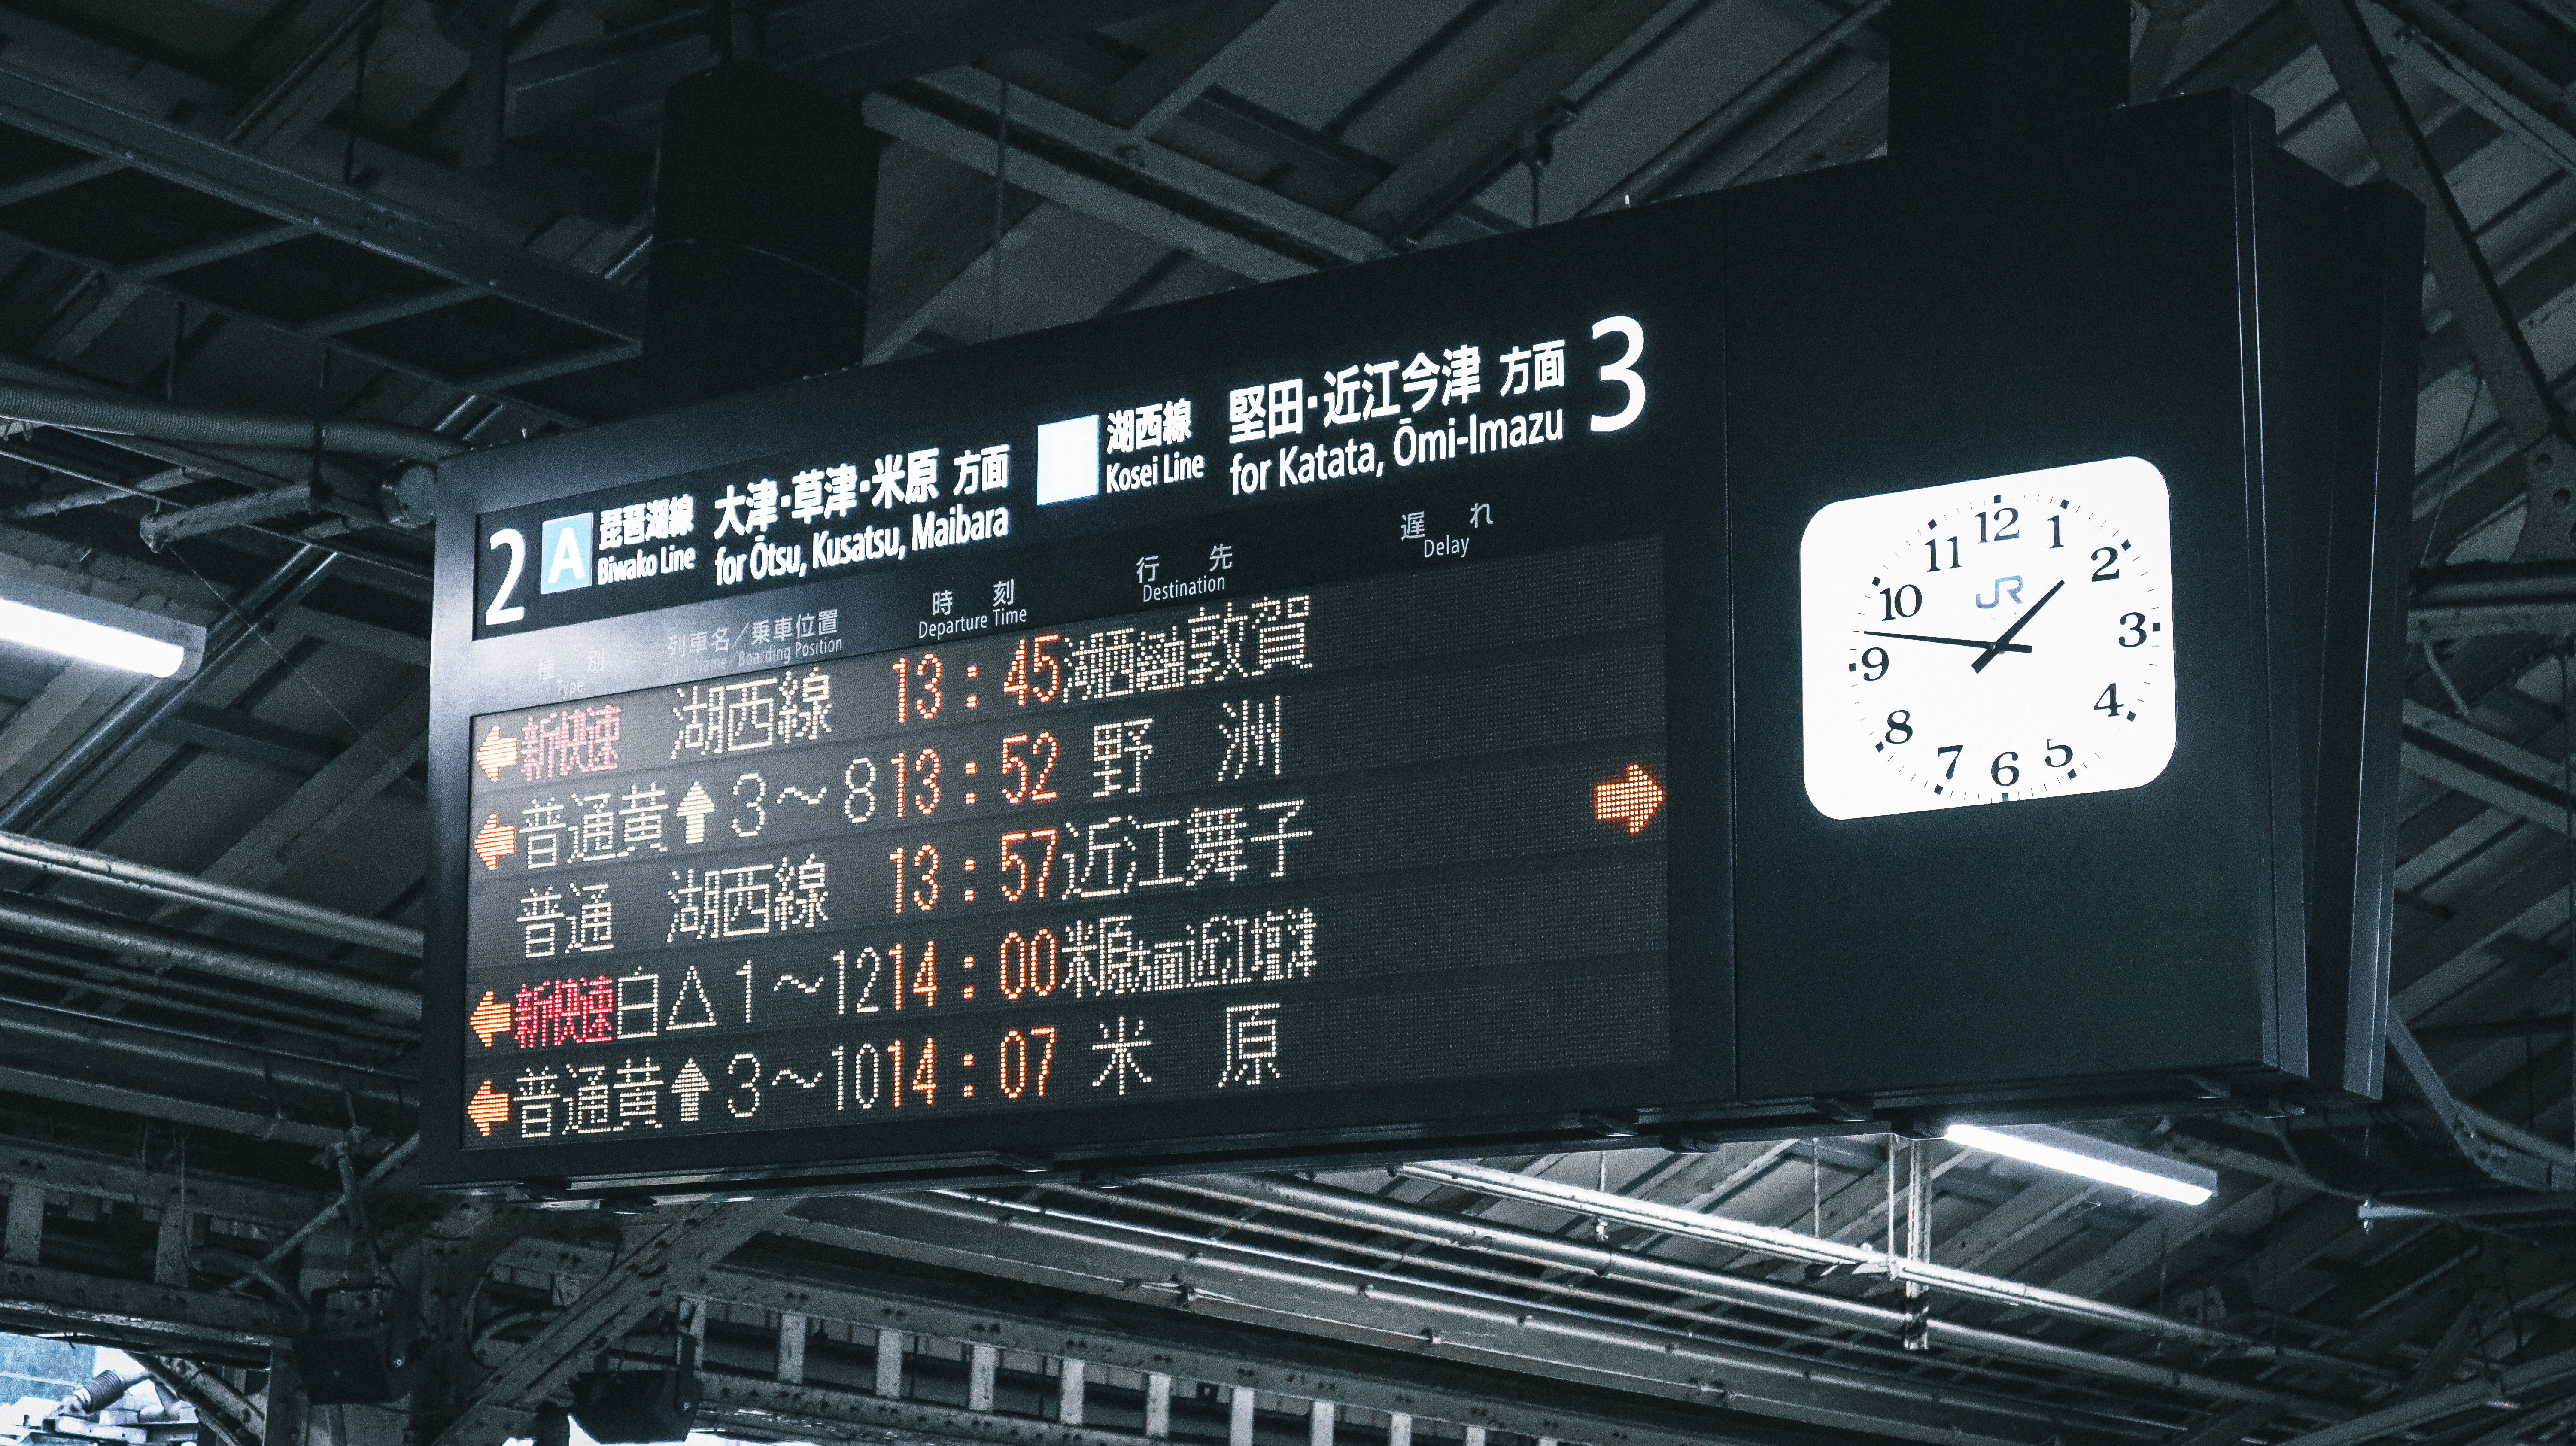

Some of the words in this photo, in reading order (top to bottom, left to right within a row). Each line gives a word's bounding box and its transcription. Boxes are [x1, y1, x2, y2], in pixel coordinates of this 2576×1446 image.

[1590, 315, 1646, 432] 3
[1106, 397, 1192, 455] 湖西線
[1229, 452, 1272, 495] for
[1279, 438, 1385, 487] Katata,
[1393, 408, 1564, 467] Ōmi-Imazu
[1106, 455, 1159, 494] Kosei
[1163, 451, 1205, 483] Line
[598, 493, 695, 550] 琵琶湖線
[1975, 507, 2020, 544] 12
[2047, 514, 2064, 550] 1
[547, 526, 587, 585] A
[714, 546, 744, 586] for
[750, 535, 811, 580] Ōtsu,
[812, 525, 906, 569] Kusatsu,
[911, 504, 1009, 551] Maibara
[1424, 535, 1470, 558] Delay
[1924, 535, 1963, 573] 11
[484, 527, 526, 626] 2
[597, 548, 659, 586] Biwako
[660, 544, 696, 574] Line
[2090, 546, 2120, 583] 2
[1142, 576, 1225, 603] Destination
[1879, 583, 1923, 622] 10
[1975, 574, 2024, 610] JR
[918, 615, 988, 641] Departure
[992, 608, 1027, 626] Time
[2118, 611, 2148, 648] 3
[795, 637, 844, 659] Position
[1861, 647, 1889, 682] 9
[556, 679, 584, 700] Type
[2093, 682, 2125, 717] 4
[519, 704, 622, 782] 新快速
[669, 666, 832, 760] 湖西線
[1884, 709, 1914, 744] 8
[1938, 744, 1964, 780] 7
[1990, 751, 2020, 787] 6
[2044, 738, 2074, 768] 5
[516, 883, 614, 958] 普通
[666, 853, 829, 943] 湖西線
[1061, 799, 1312, 900] 近江舞子
[514, 974, 614, 1049] 新快速
